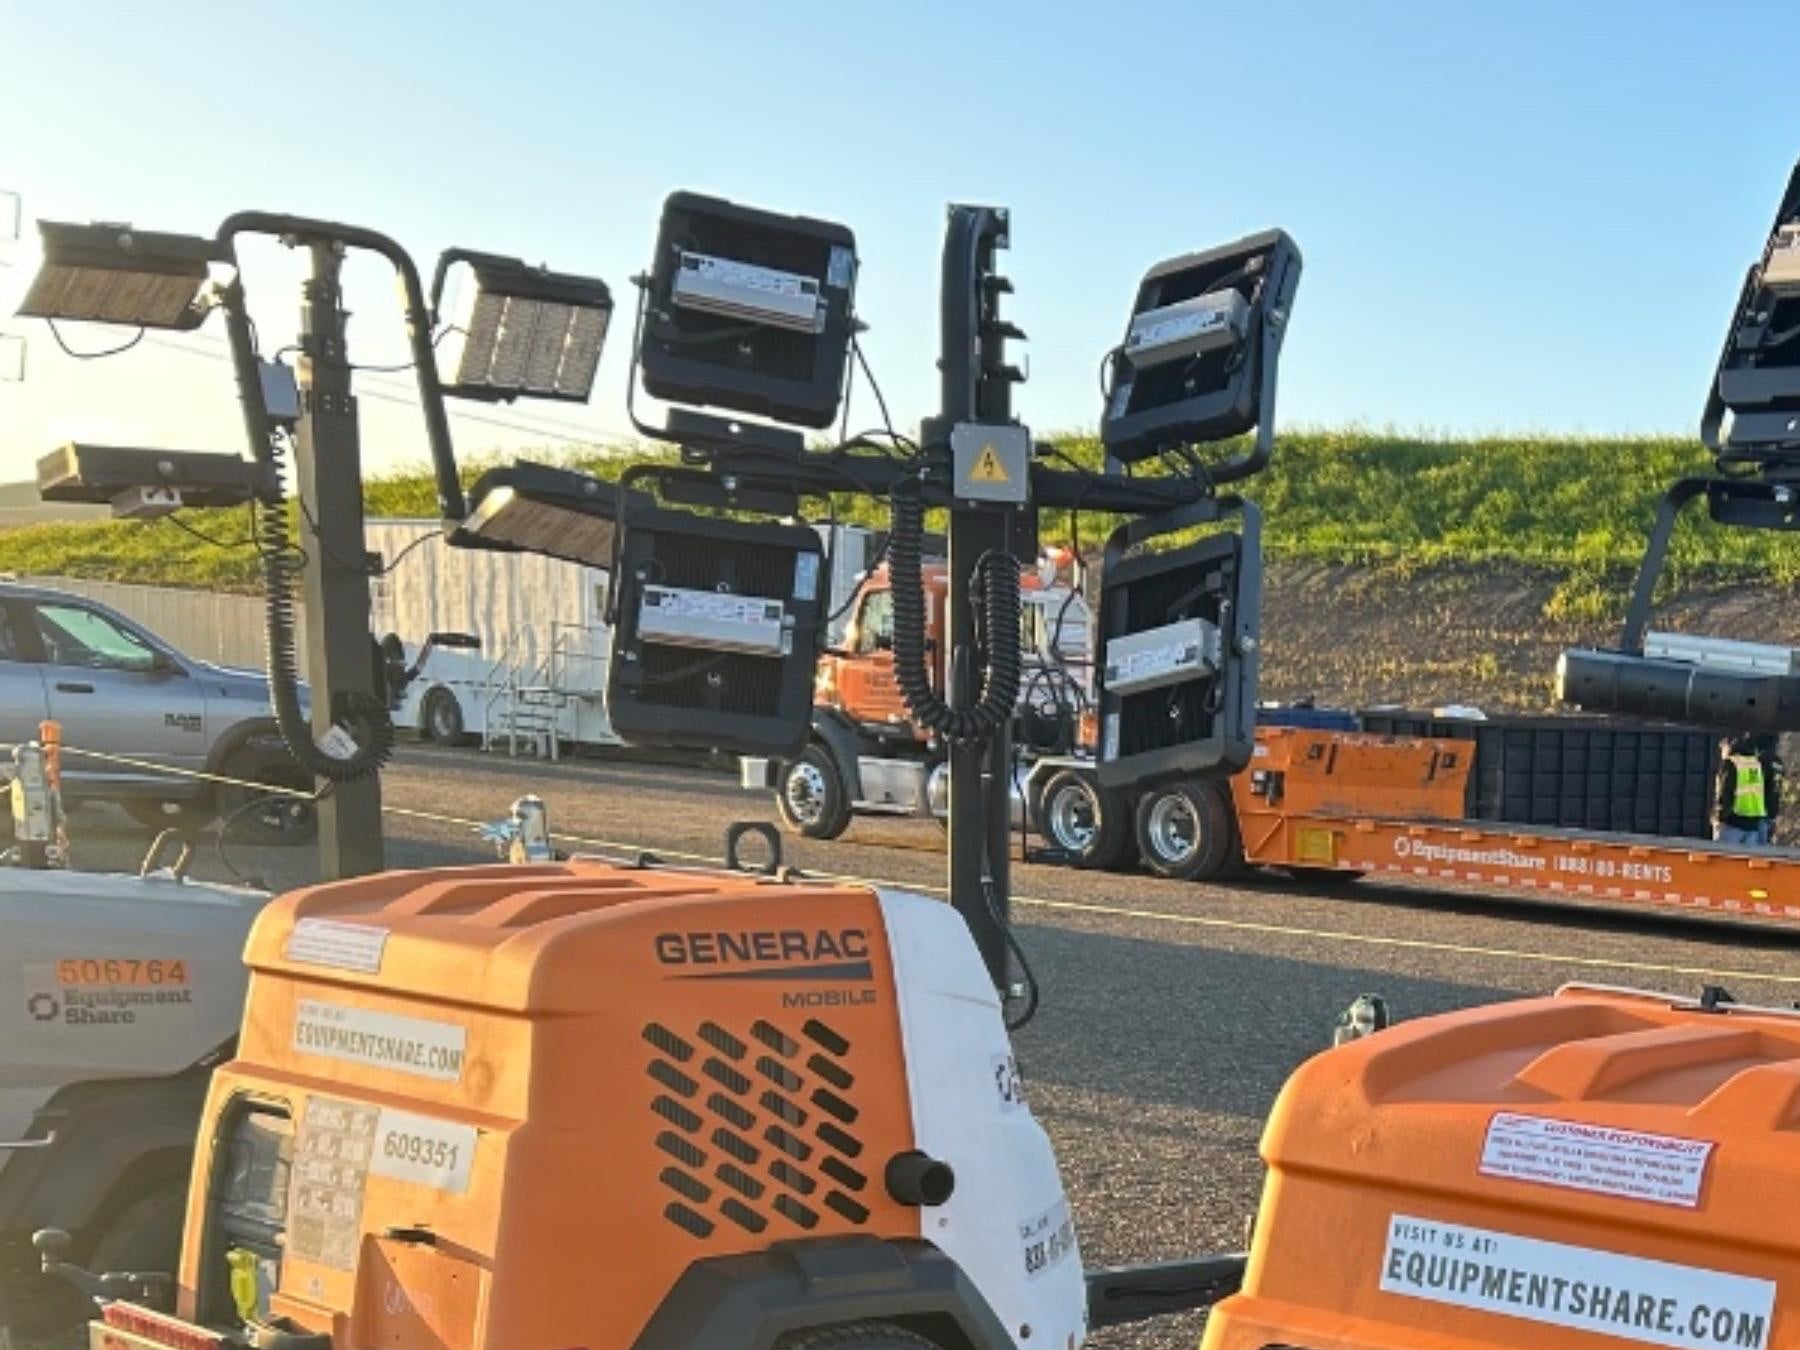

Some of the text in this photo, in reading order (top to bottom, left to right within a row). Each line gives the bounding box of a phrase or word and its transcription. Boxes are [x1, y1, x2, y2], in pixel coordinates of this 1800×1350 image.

[655, 929, 868, 965] GENERAC
[58, 958, 187, 985] 506764
[63, 988, 192, 1008] Equipment
[782, 989, 877, 1009] MOBILE
[65, 1007, 136, 1025] Share
[384, 1130, 459, 1171] 609351
[1394, 1222, 1437, 1245] VISIT
[1443, 1230, 1465, 1250] US
[1387, 1246, 1765, 1350] EQUIPMENTSHARE.COM
